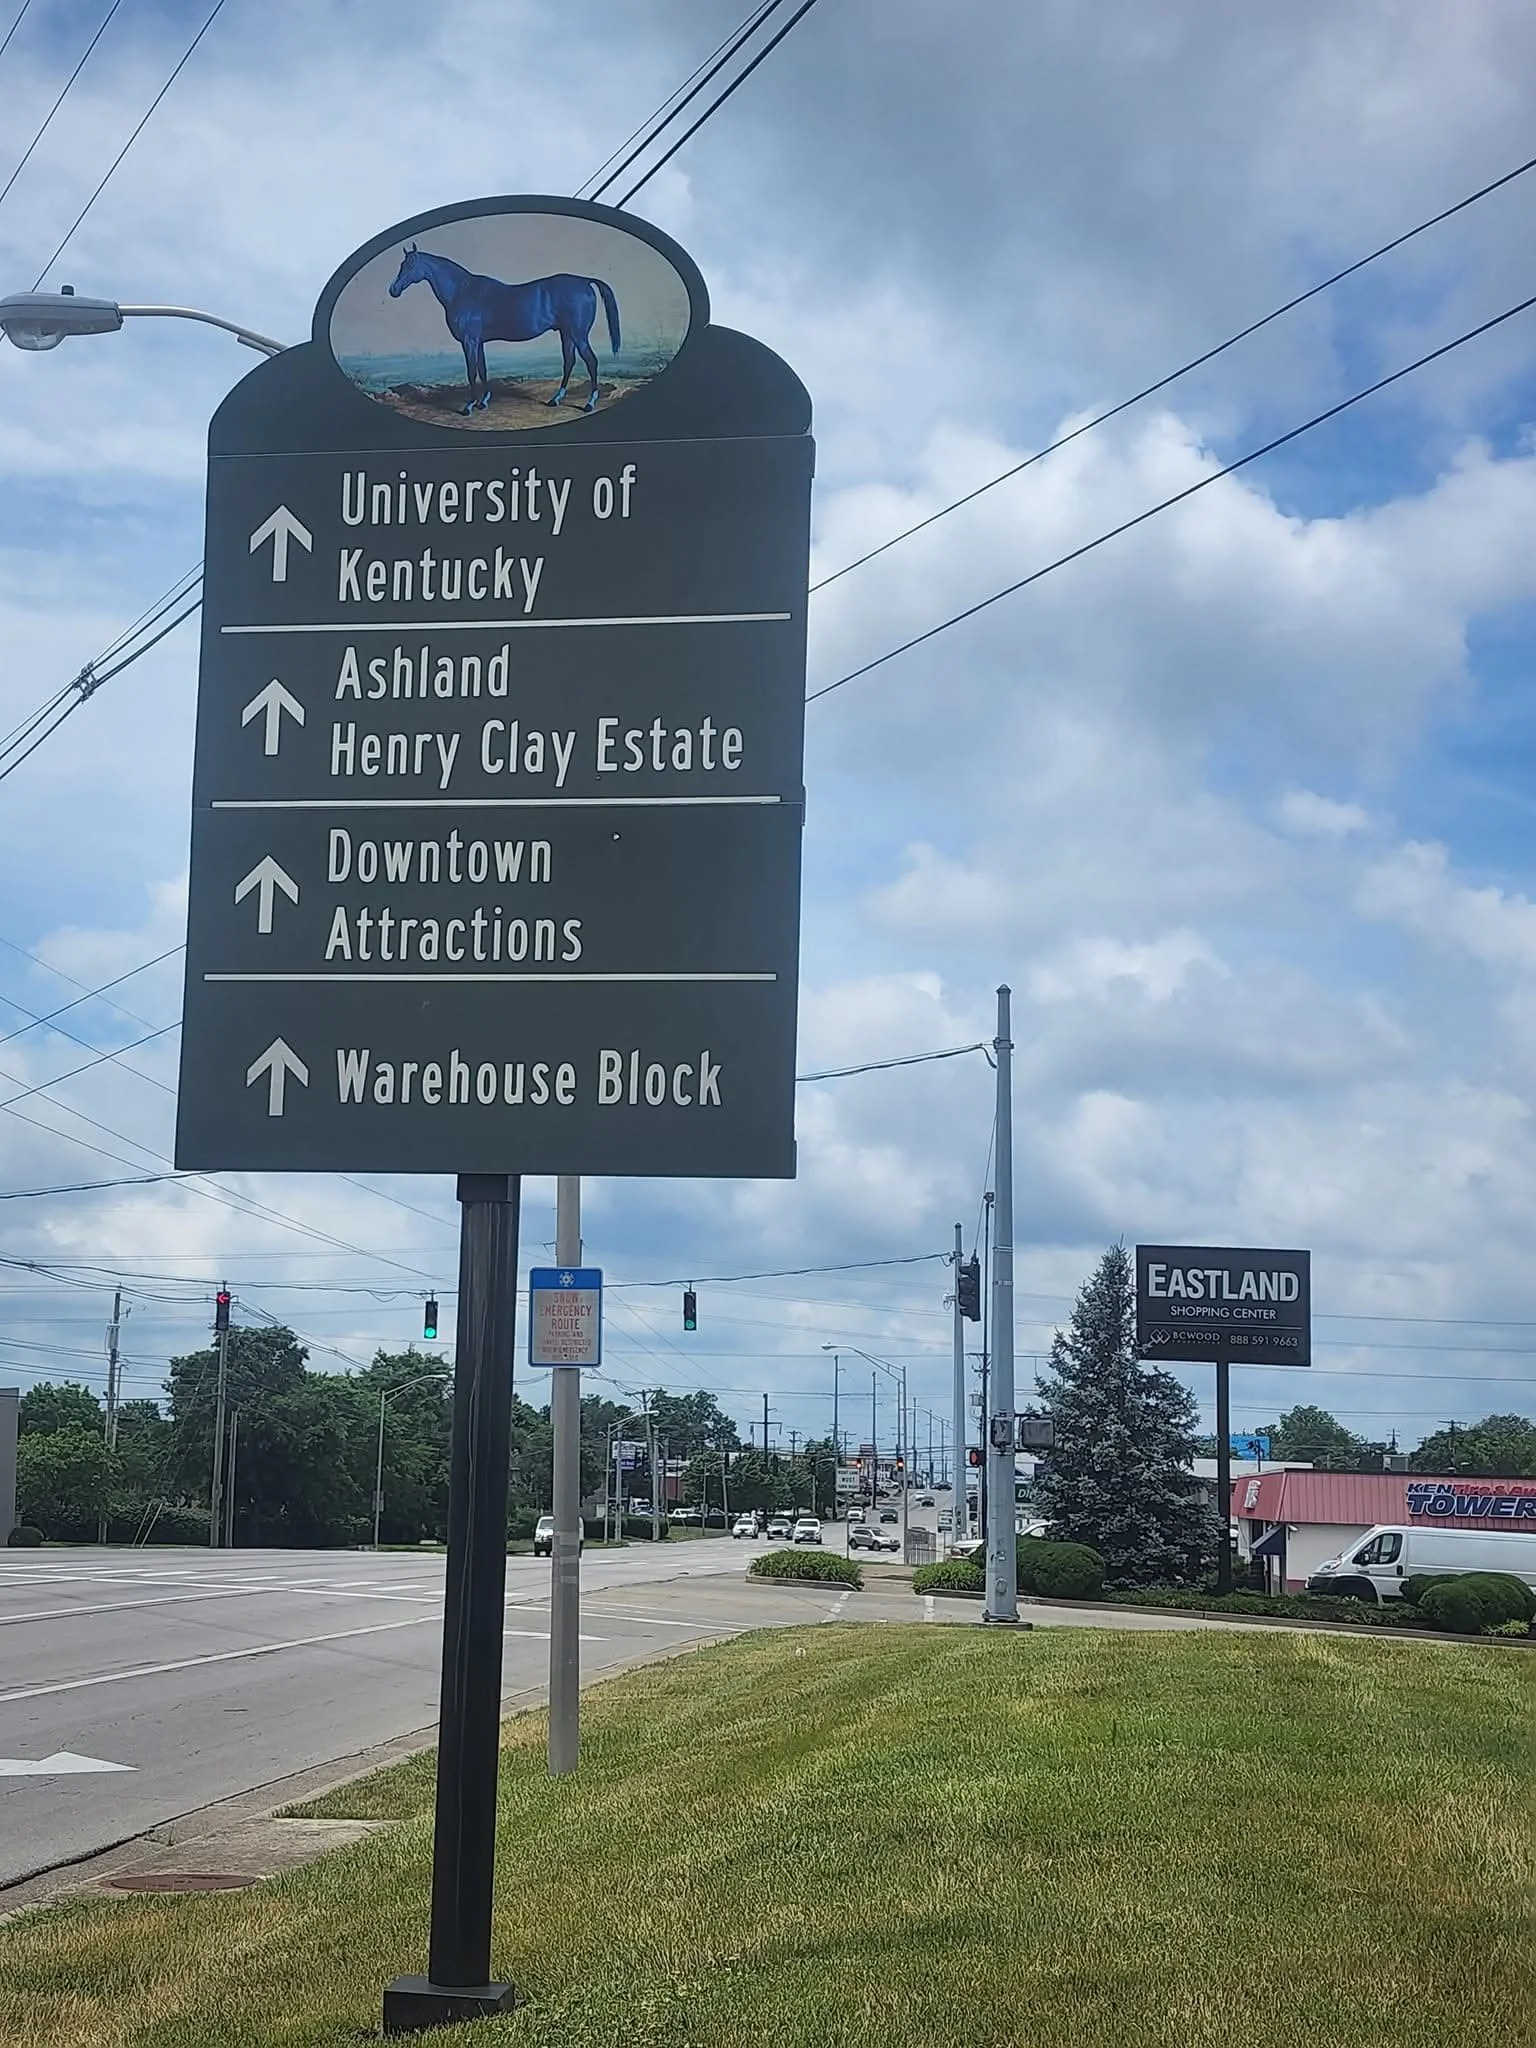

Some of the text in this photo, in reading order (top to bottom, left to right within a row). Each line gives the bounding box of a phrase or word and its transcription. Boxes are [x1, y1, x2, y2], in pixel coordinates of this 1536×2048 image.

[342, 464, 637, 536] University of
[339, 546, 544, 613] Kentucky
[335, 643, 510, 699] Ashland
[330, 716, 744, 789] Henry Clay Estate
[328, 828, 552, 883] Downtown
[324, 906, 583, 961] Attractions
[336, 1048, 723, 1106] Warehouse Block
[1148, 1263, 1300, 1302] EASTLAND
[540, 1305, 592, 1317] EMERGENCY
[551, 1318, 580, 1330] ROUTE
[1170, 1305, 1277, 1320] SHOPPING CENTER
[1173, 1331, 1221, 1340] BCWOOD
[1230, 1335, 1249, 1345] 888
[1252, 1335, 1270, 1345] 591
[1273, 1336, 1298, 1347] 9663
[1407, 1494, 1536, 1518] TOWER
